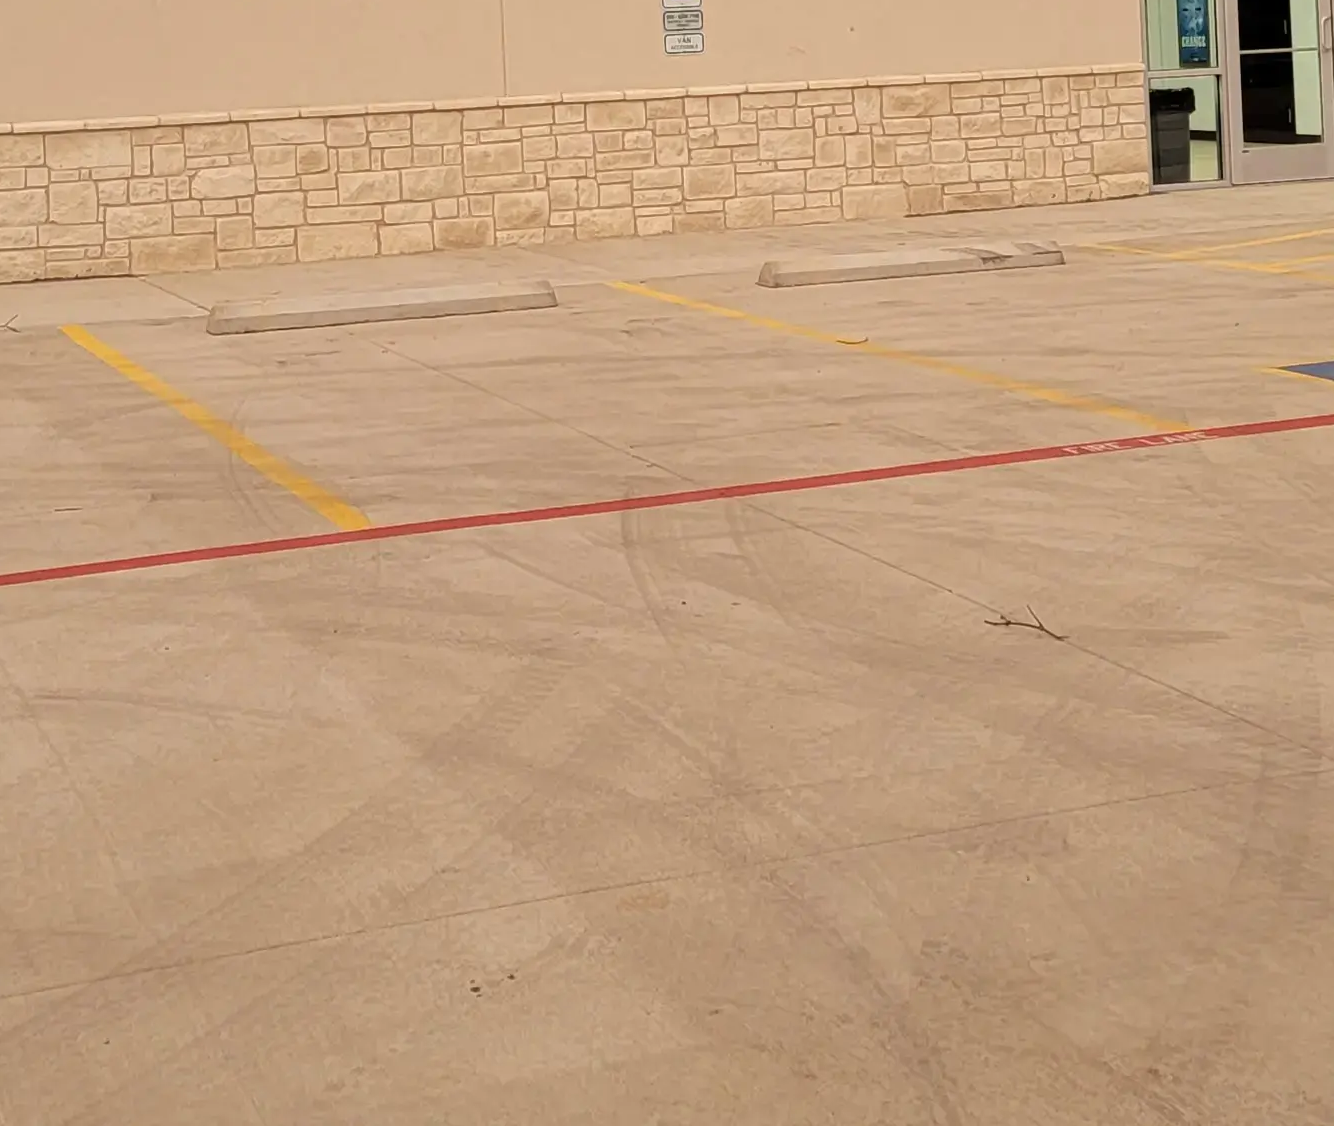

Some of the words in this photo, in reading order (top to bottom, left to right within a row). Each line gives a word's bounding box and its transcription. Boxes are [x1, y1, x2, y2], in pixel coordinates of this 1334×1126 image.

[677, 36, 692, 44] VAN
[1063, 441, 1132, 454] FIRE
[1138, 431, 1217, 446] LANE
